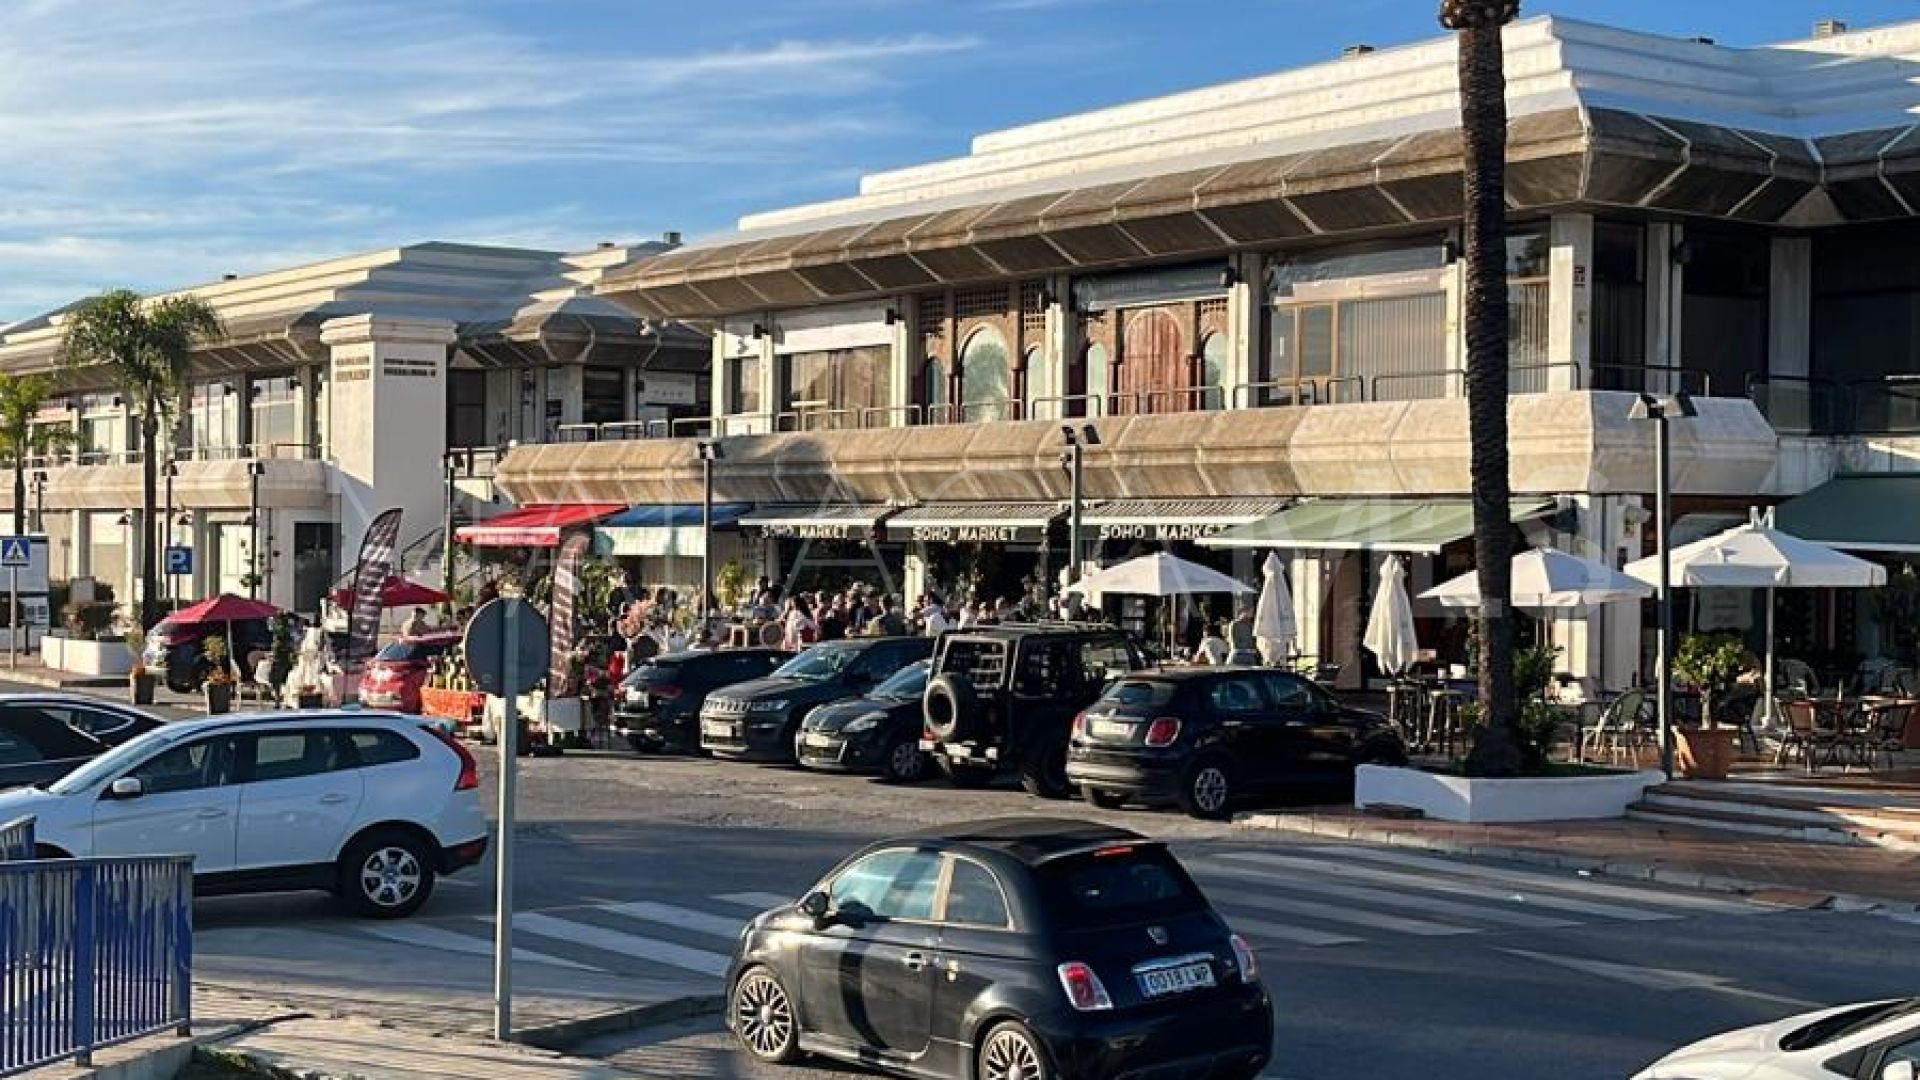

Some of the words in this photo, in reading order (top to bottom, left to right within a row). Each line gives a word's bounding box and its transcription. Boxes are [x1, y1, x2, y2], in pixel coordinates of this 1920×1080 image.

[799, 524, 848, 539] MARKET
[912, 525, 950, 541] SOHO
[957, 525, 1018, 541] MARKET
[1100, 523, 1144, 539] SOHO
[168, 550, 186, 571] P
